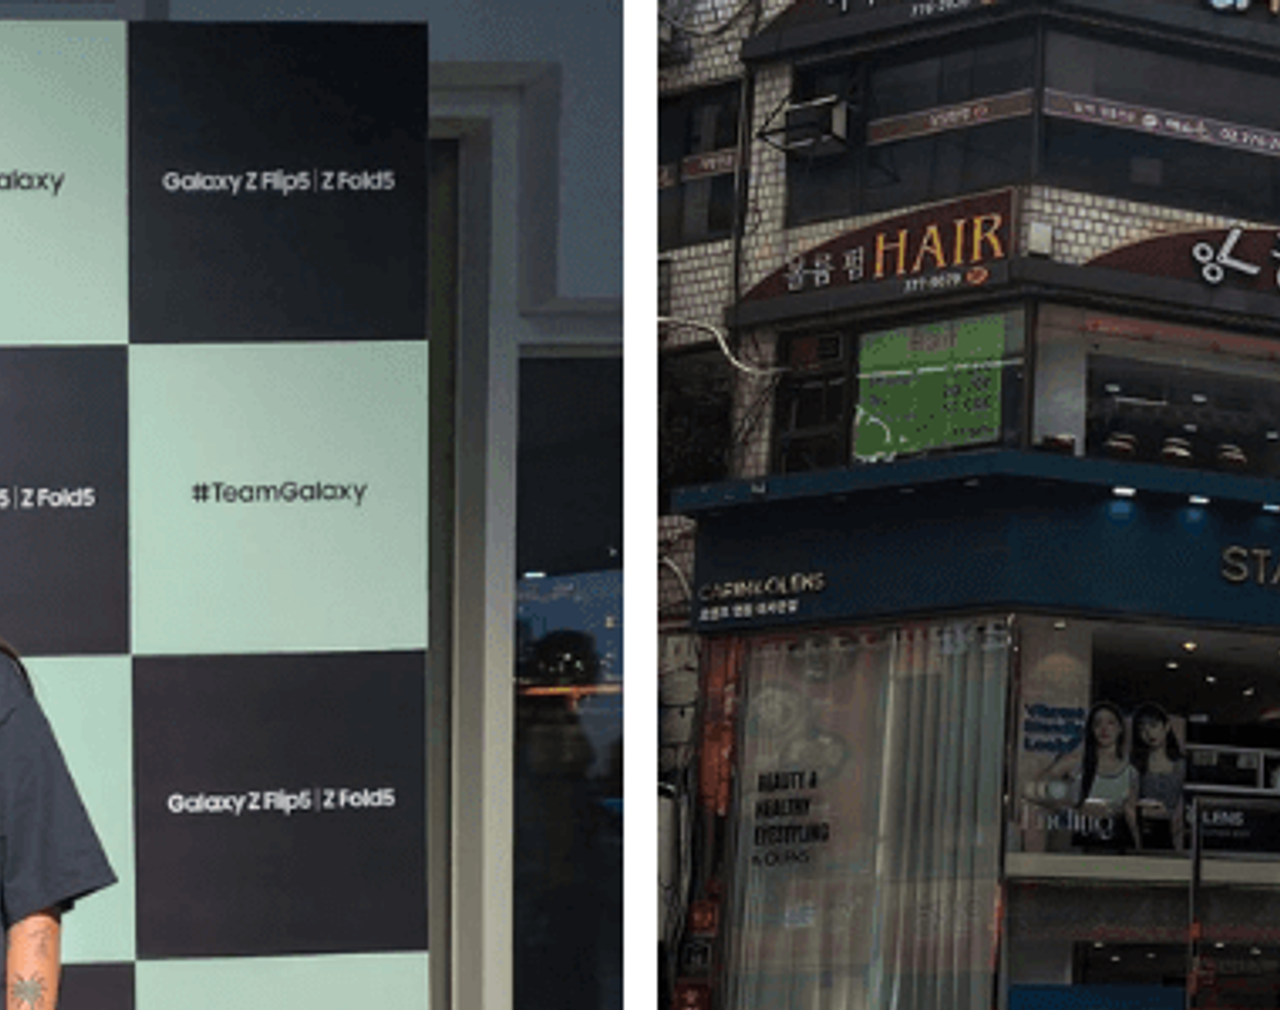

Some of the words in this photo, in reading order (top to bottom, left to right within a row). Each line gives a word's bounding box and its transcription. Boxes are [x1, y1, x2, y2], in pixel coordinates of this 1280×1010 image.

[162, 172, 242, 194] Galaxy
[246, 172, 257, 190] Z
[261, 170, 310, 195] Flip5
[322, 172, 334, 190] Z
[337, 171, 395, 190] Fold5
[874, 215, 1004, 279] HAIR
[21, 489, 33, 507] Z
[37, 488, 95, 507] Fold5
[193, 482, 367, 506] #TeamGalaxy
[168, 794, 246, 814] Galaxy
[247, 792, 261, 810] Z
[263, 790, 311, 814] Flip5
[323, 789, 335, 808] Z
[339, 788, 395, 807] Fold5
